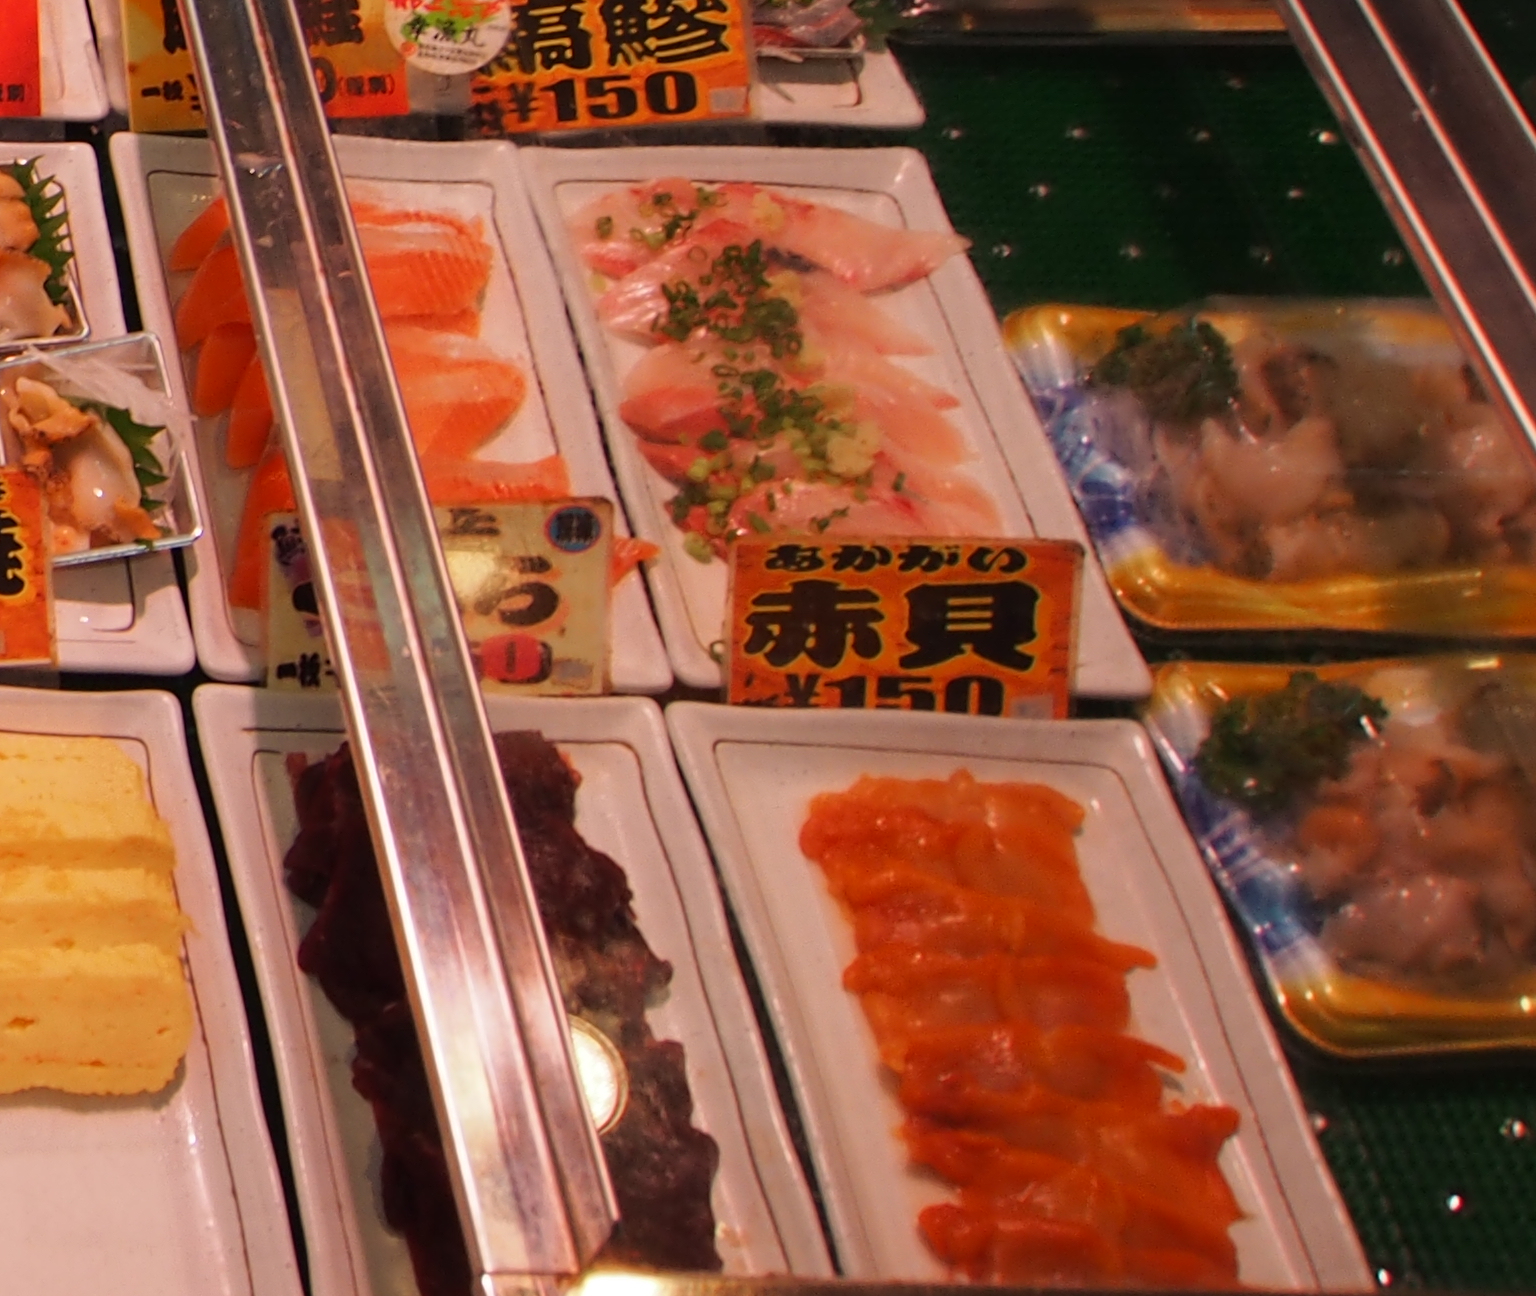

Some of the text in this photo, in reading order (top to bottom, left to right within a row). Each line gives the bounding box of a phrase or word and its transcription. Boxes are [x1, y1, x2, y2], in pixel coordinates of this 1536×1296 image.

[764, 543, 1027, 573] あかがい
[744, 579, 1040, 672] 赤貝
